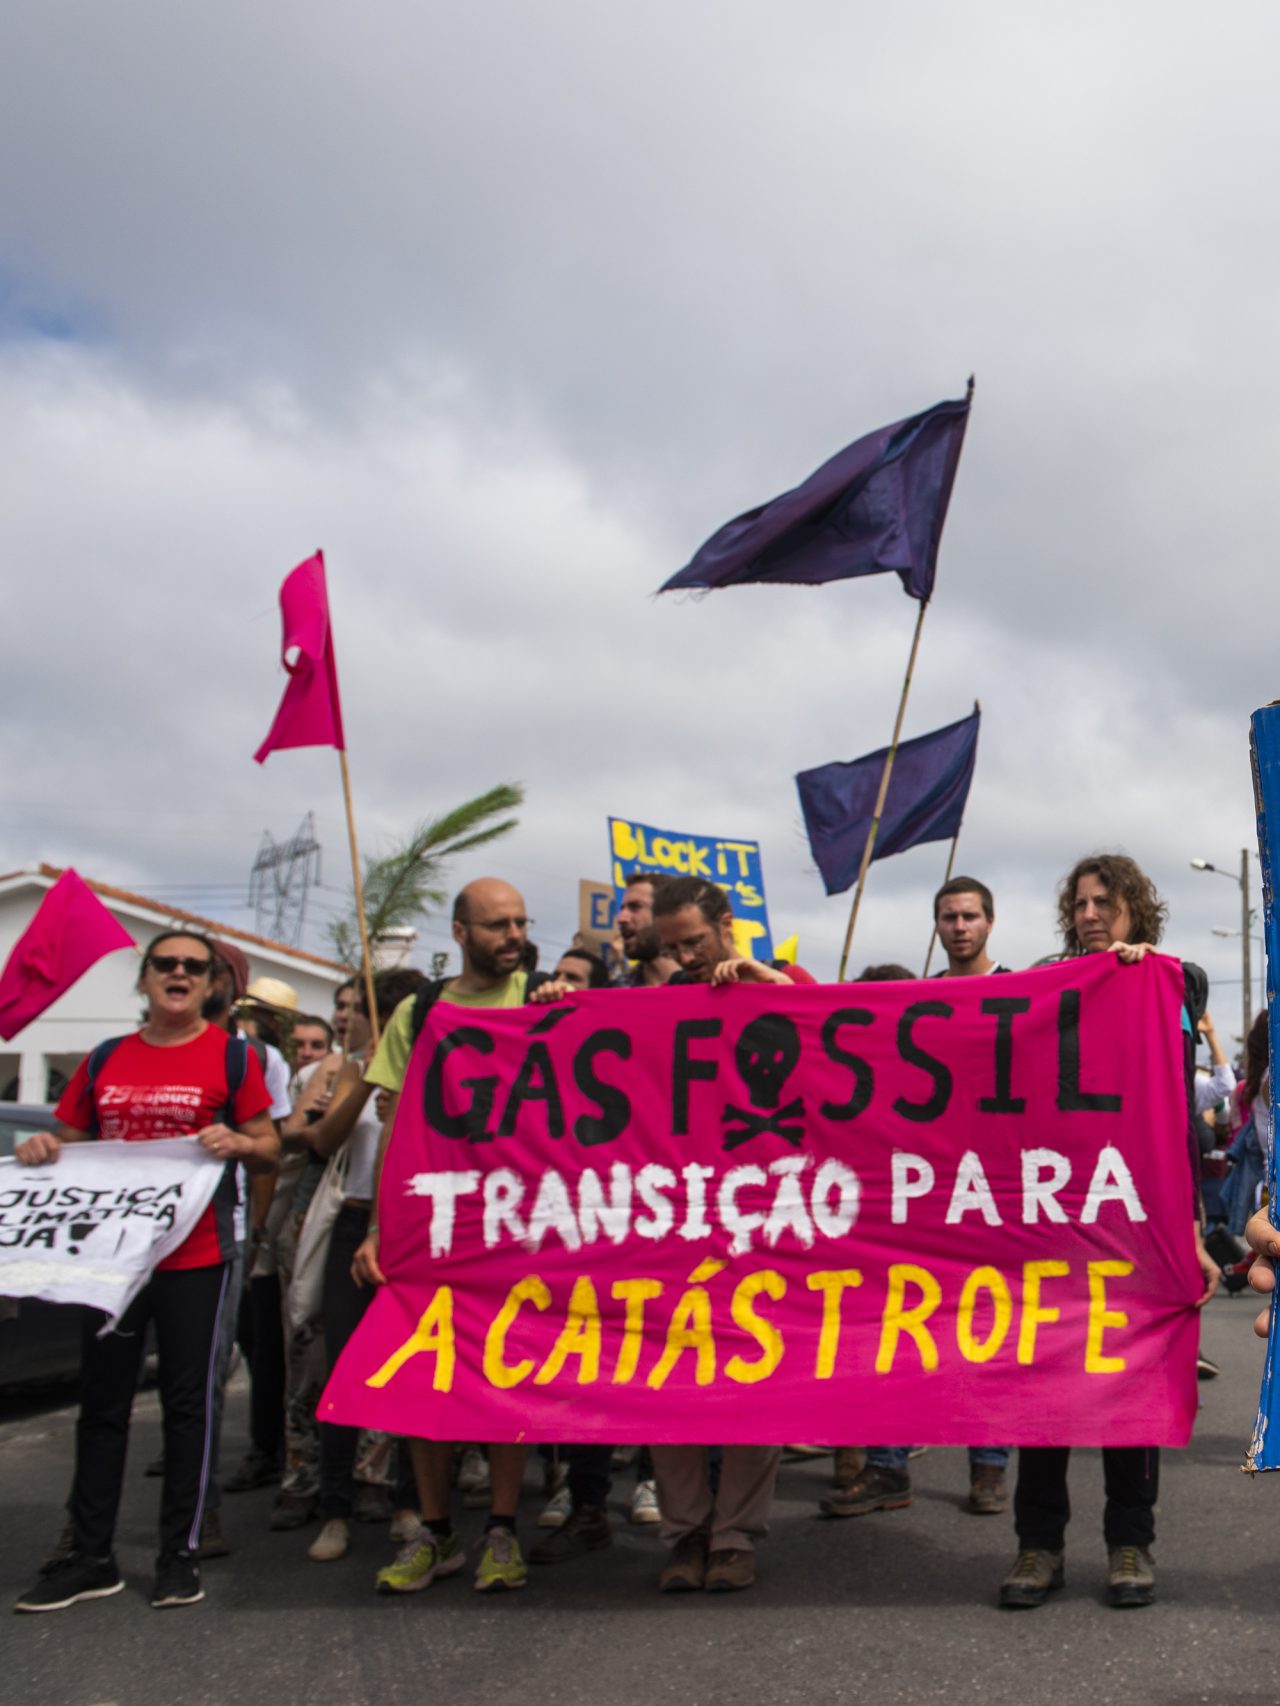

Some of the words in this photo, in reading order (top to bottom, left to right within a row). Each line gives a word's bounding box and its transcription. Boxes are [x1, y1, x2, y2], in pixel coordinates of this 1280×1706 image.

[611, 819, 712, 876] BLOCK
[422, 1006, 632, 1146] GÁS
[405, 1155, 860, 1256] TRANSIÇÃO
[890, 1143, 1147, 1226] PARA
[365, 1286, 454, 1392] A
[483, 1257, 1135, 1389] CATÁSTROFE
